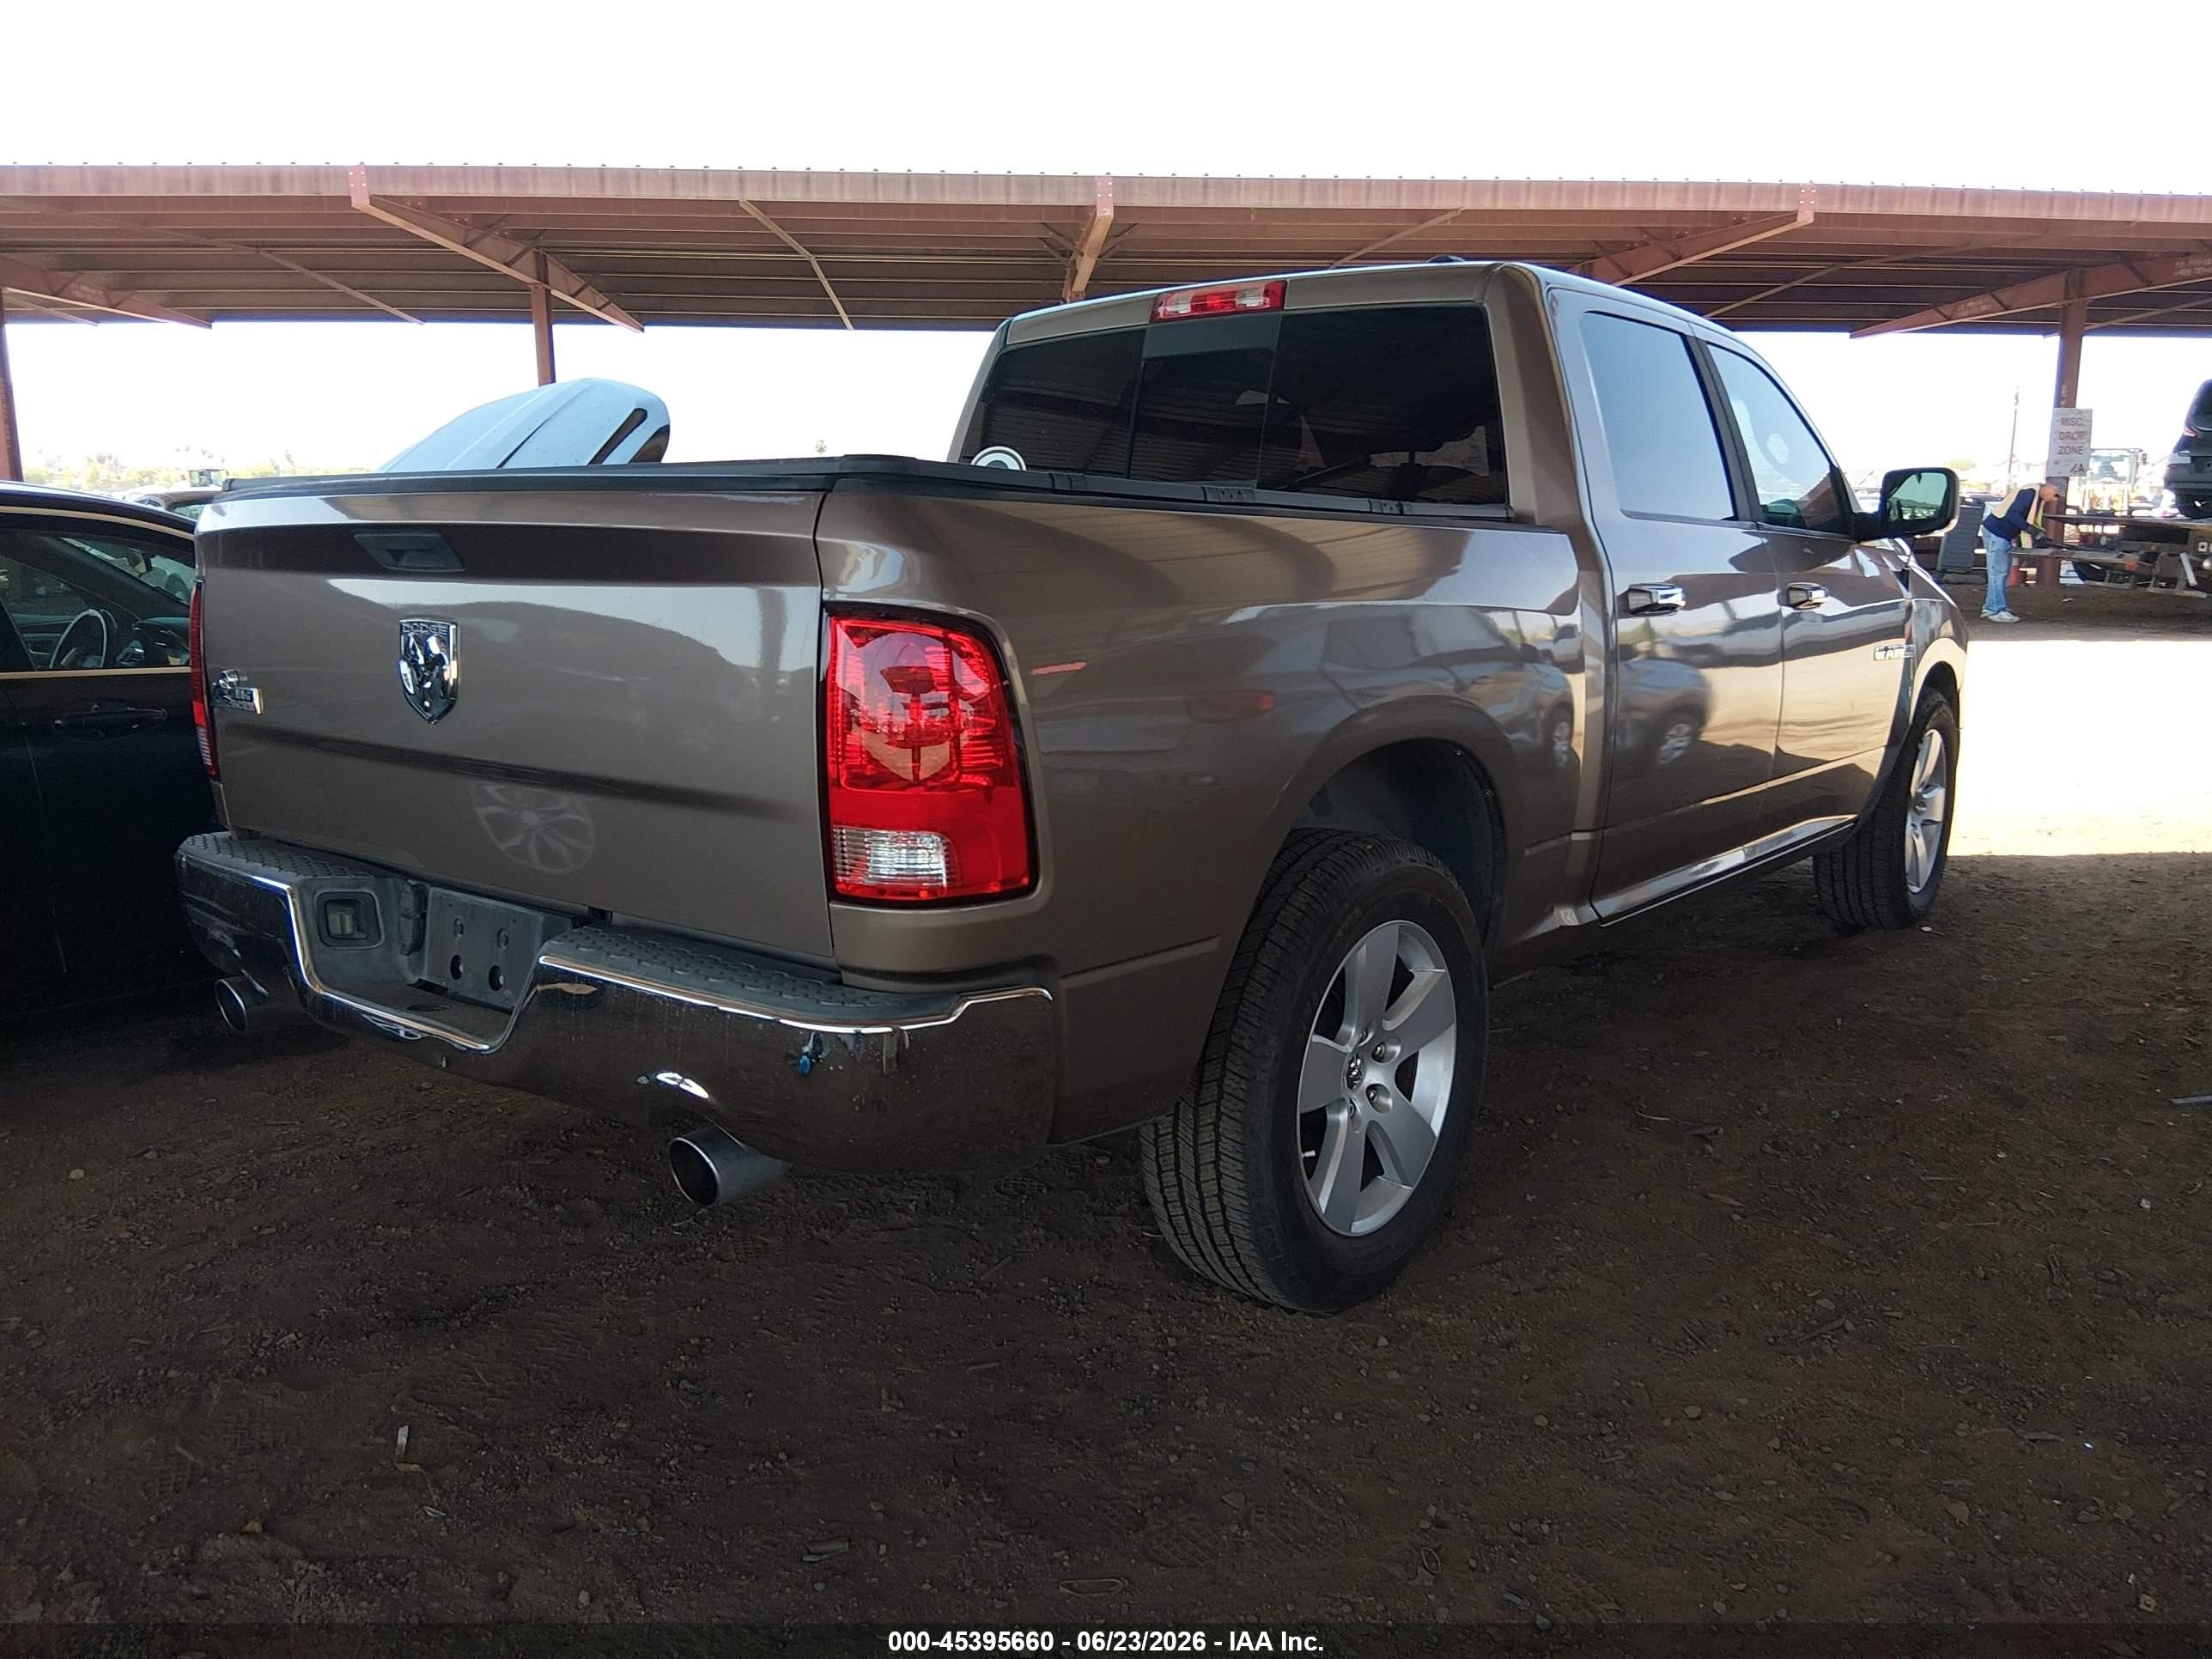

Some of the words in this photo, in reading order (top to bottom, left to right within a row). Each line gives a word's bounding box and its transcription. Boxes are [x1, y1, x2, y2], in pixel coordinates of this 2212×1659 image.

[2058, 431, 2086, 441] DROP
[2057, 446, 2084, 455] ZONE
[402, 622, 449, 636] DODGE
